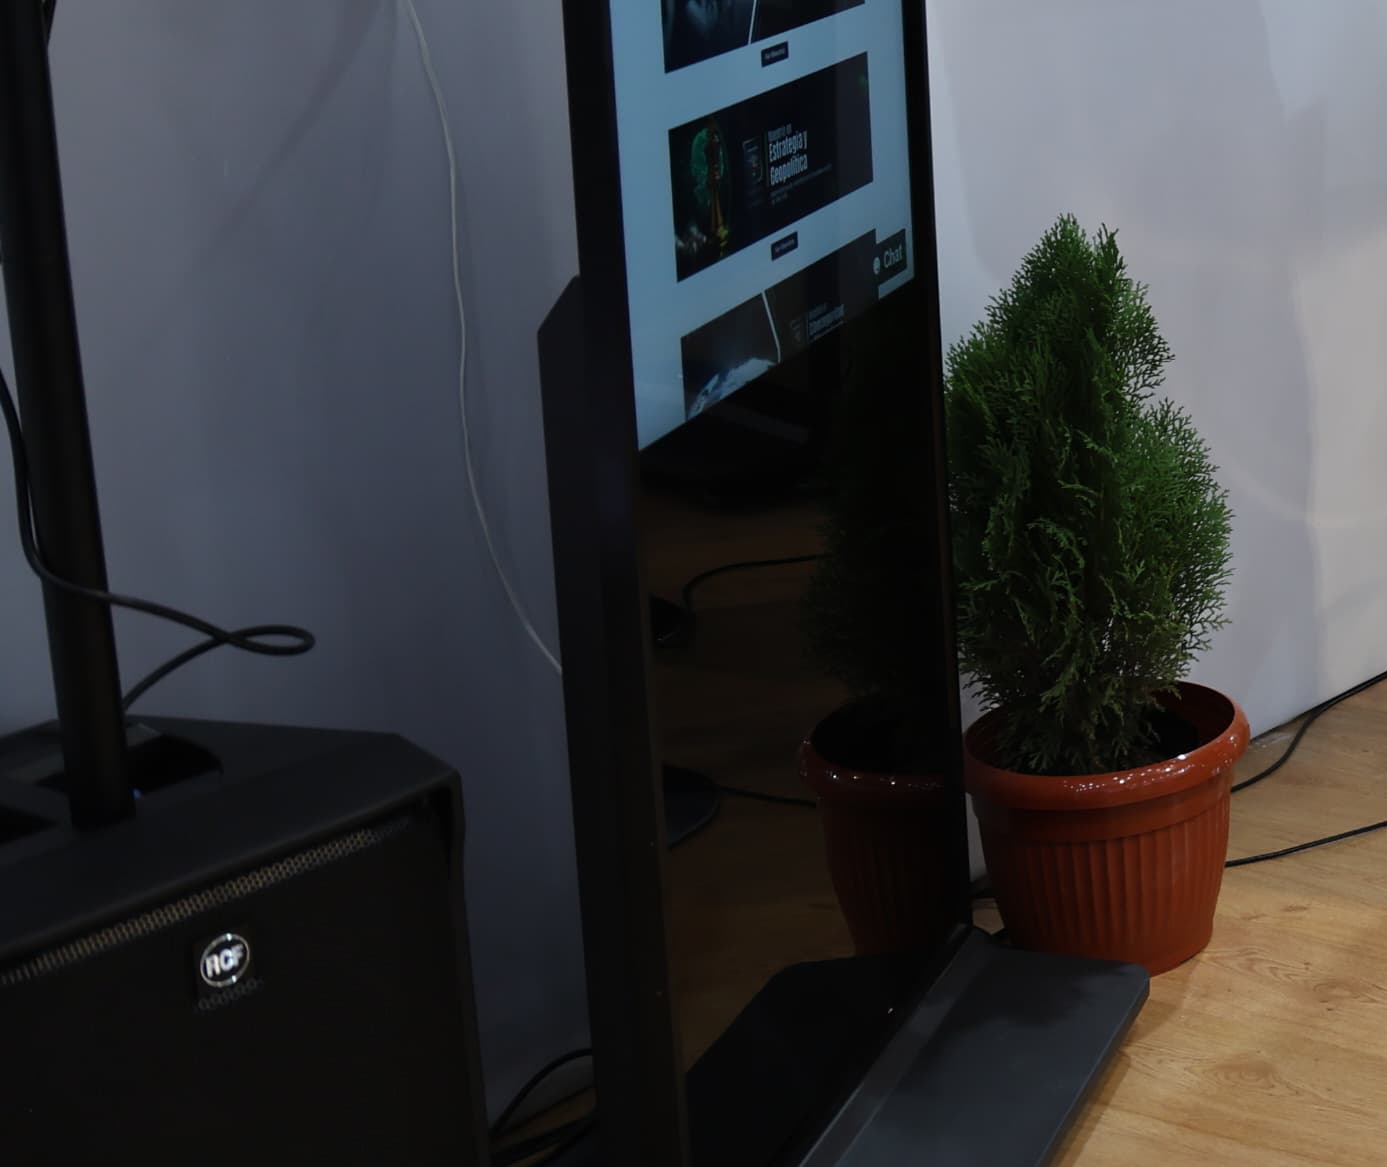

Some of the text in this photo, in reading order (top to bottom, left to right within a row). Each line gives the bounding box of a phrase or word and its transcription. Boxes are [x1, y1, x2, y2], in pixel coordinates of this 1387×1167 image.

[769, 131, 807, 162] Estrategia y
[770, 153, 808, 185] Geopolítica
[883, 243, 903, 268] Chat
